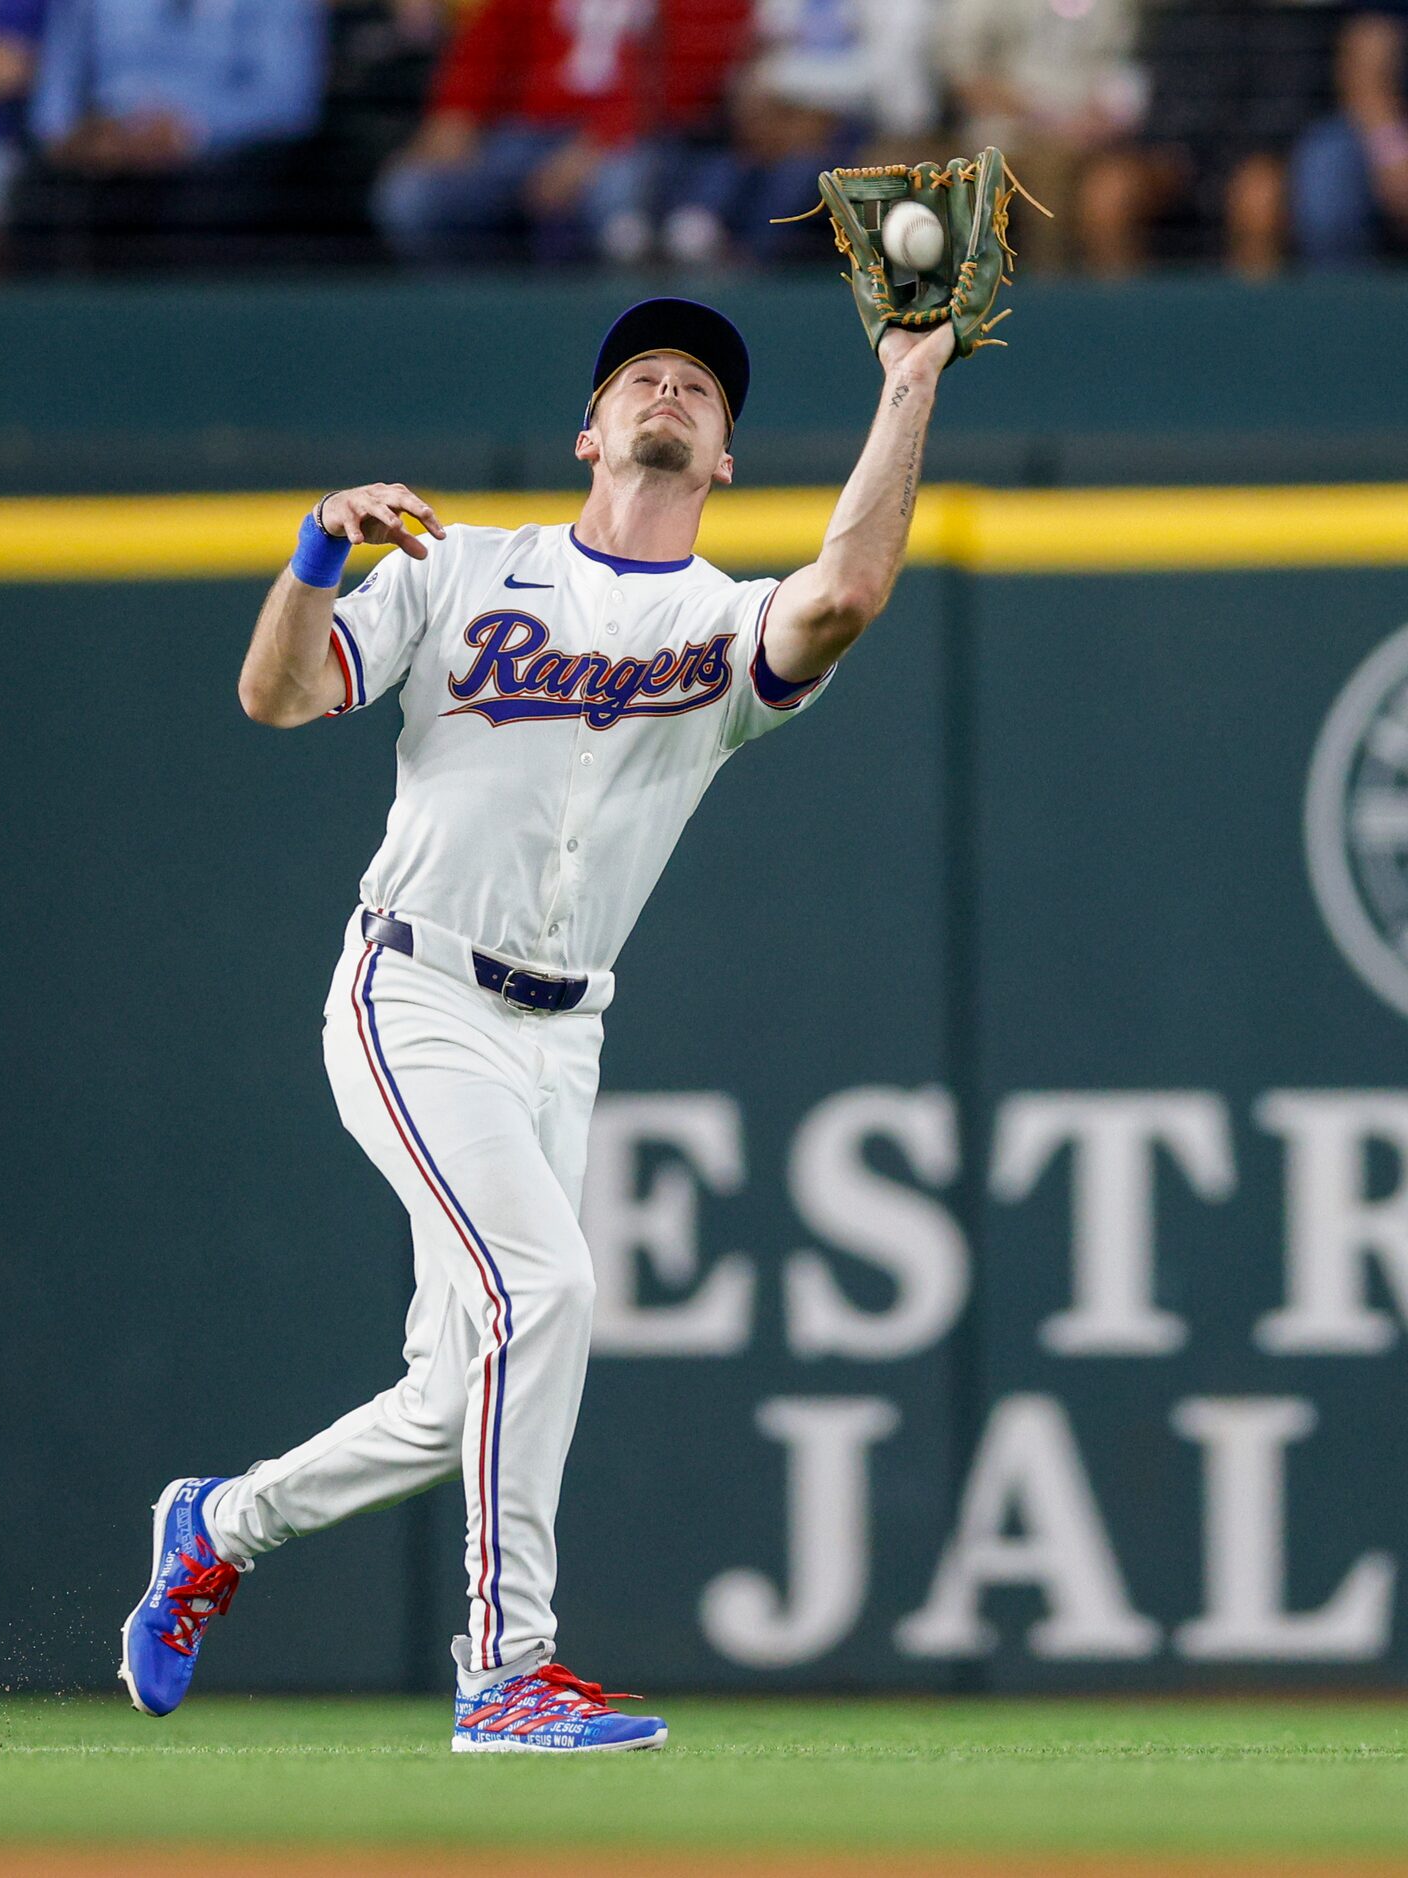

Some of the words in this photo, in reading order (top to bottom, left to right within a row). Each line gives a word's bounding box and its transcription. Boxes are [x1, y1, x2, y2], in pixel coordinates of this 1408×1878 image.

[438, 609, 737, 731] Rangers
[175, 1478, 213, 1503] 32
[698, 1390, 1395, 1669] JAL
[550, 1721, 584, 1734] JESUS
[525, 1734, 552, 1746] JESUS
[553, 1735, 575, 1747] WON
